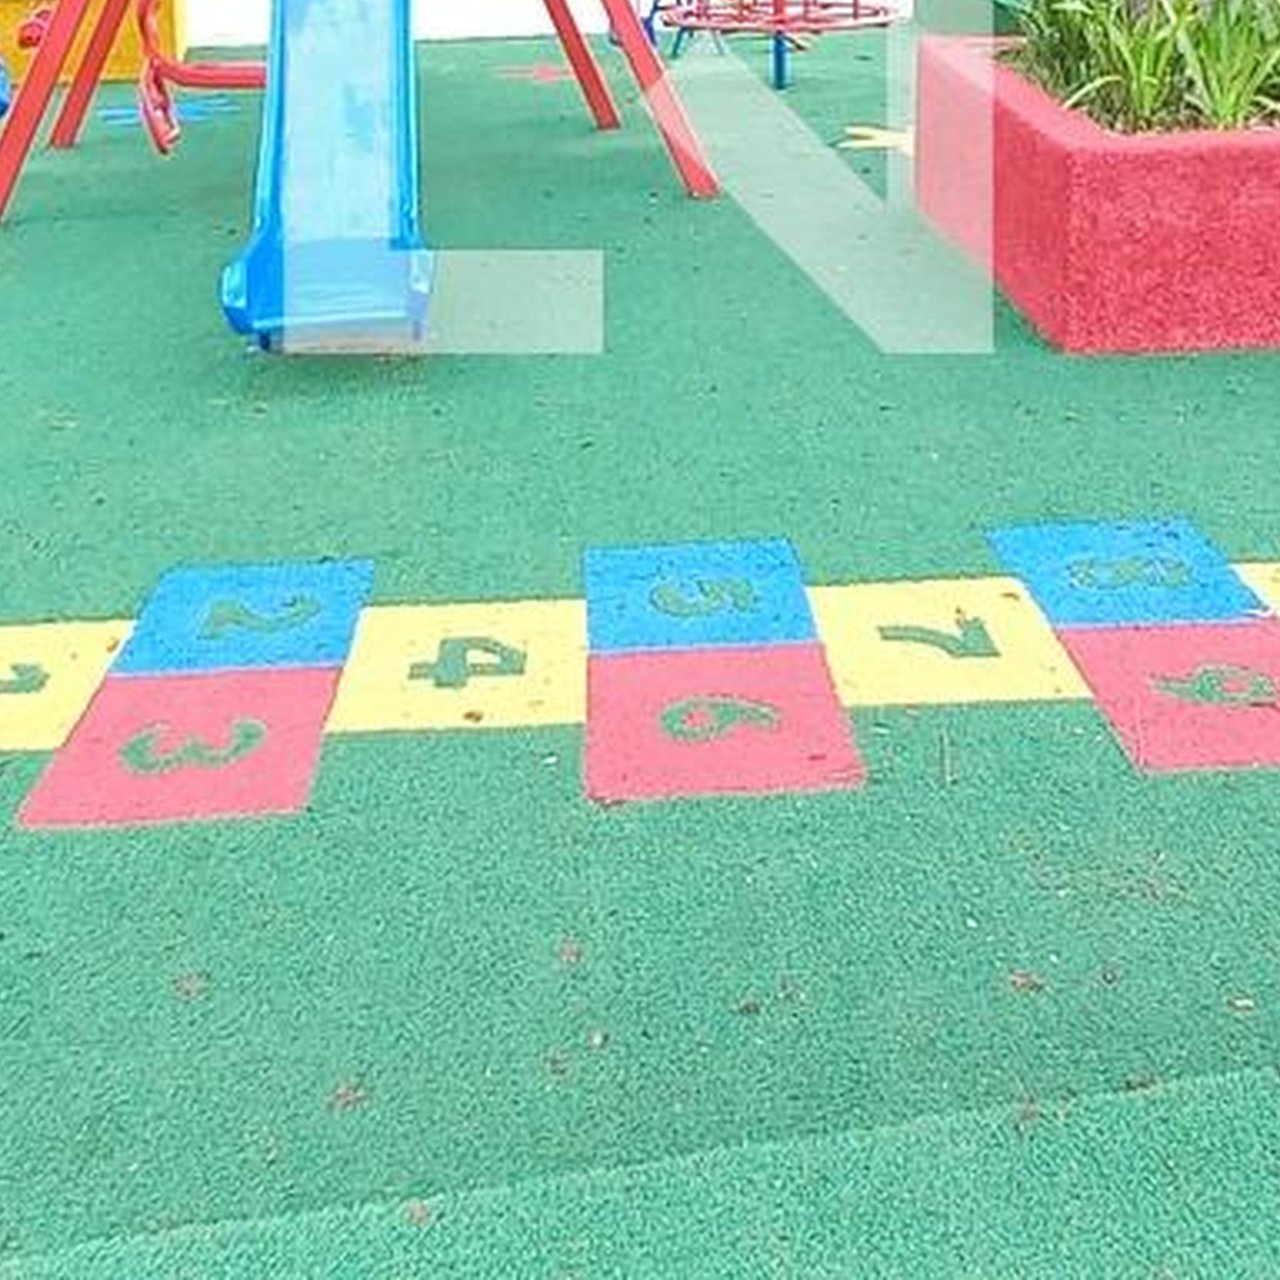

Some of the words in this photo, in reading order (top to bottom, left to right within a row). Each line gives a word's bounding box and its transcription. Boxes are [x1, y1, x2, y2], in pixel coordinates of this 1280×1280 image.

[199, 592, 320, 641] 2
[648, 576, 758, 617] 5
[408, 635, 526, 689] 4
[876, 616, 1001, 659] 7
[119, 718, 267, 776] 3
